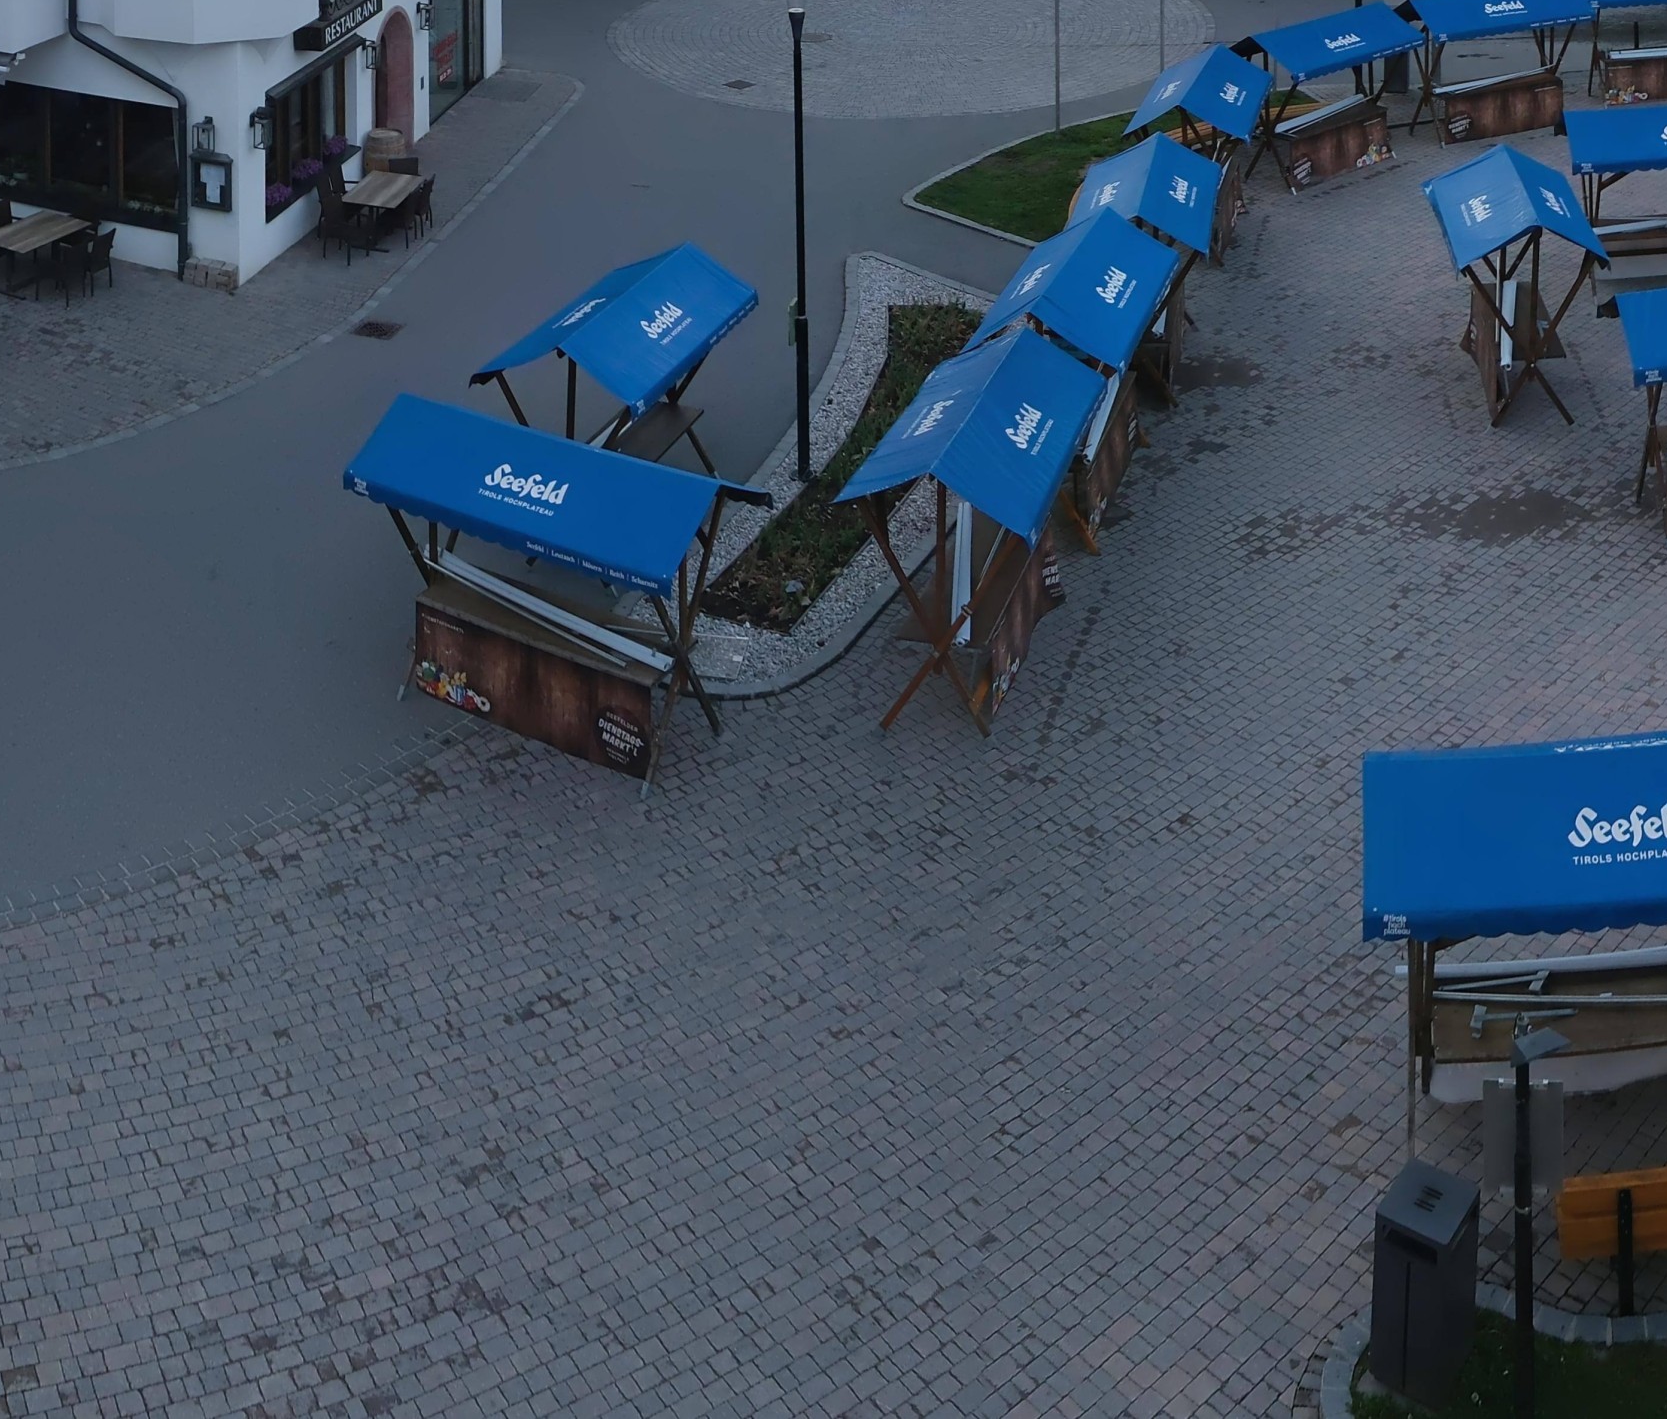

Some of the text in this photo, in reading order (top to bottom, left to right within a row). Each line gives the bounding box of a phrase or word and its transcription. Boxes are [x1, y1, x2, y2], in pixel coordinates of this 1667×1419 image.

[1484, 0, 1525, 14] Seefeld
[640, 301, 683, 339] Seefeld
[1005, 402, 1043, 450] Seefeld
[484, 463, 570, 505] Seefeld
[478, 487, 555, 517] TIROLS HOCHPLATEAU
[598, 717, 645, 748] DIENSTAGS-
[602, 731, 638, 758] MARKT'L
[1572, 854, 1613, 866] TIROLS
